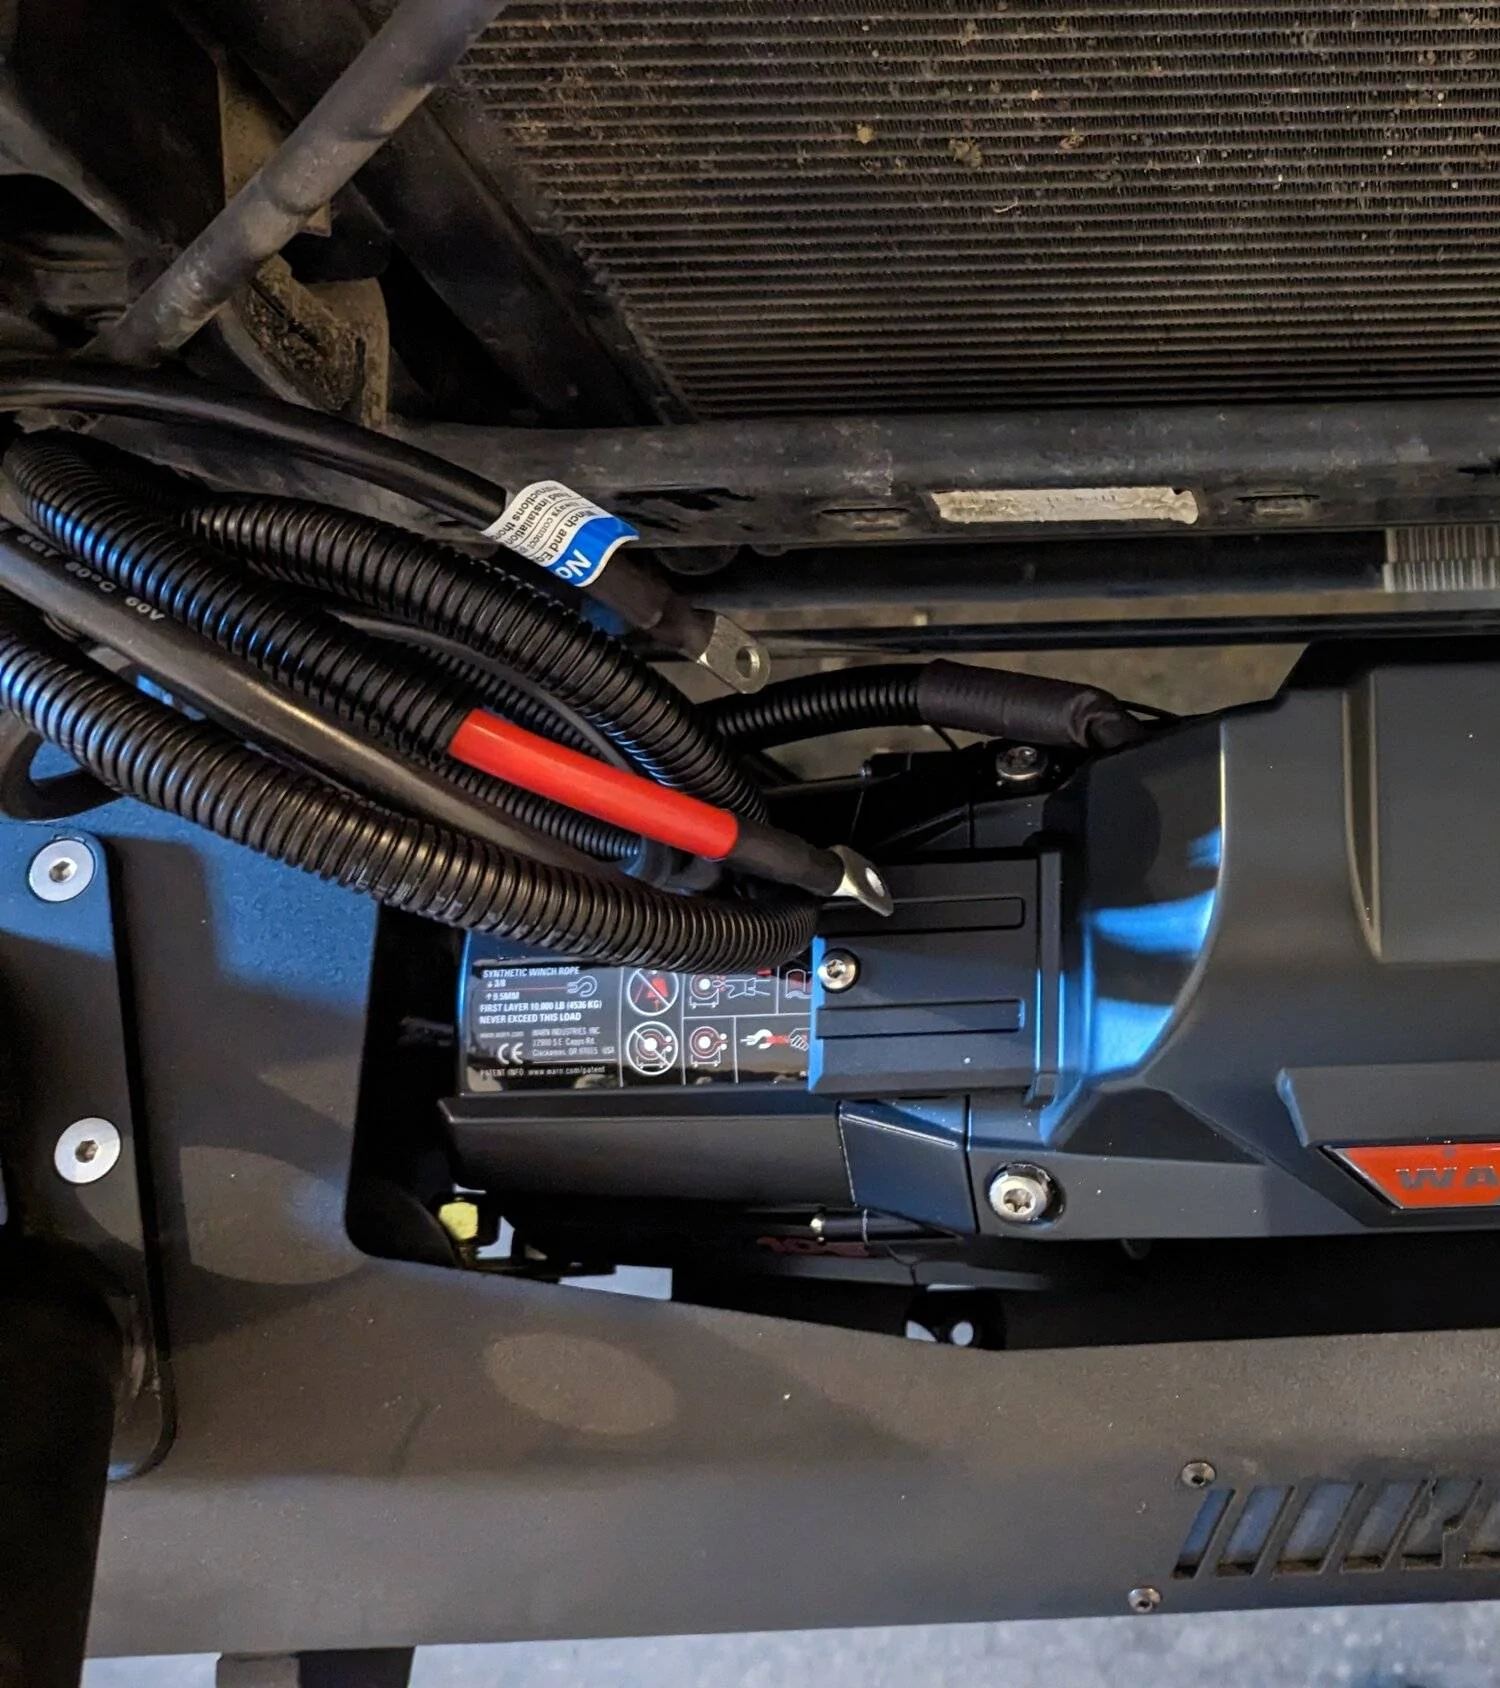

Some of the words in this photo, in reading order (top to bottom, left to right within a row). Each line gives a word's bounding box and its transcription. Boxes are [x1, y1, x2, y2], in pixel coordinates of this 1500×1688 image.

[504, 497, 552, 546] installation
[527, 516, 555, 550] connect
[548, 528, 568, 553] and
[124, 596, 166, 621] 60V
[483, 968, 528, 979] SYNTHETIC
[528, 966, 557, 977] WINCH
[559, 965, 580, 976] ROPE
[480, 1003, 502, 1013] FIRST
[503, 1001, 529, 1012] LAYER
[555, 1000, 565, 1010] LB
[480, 1015, 507, 1025] NEVER
[507, 1013, 538, 1024] EXCEED
[539, 1013, 559, 1022] THIS
[559, 1012, 582, 1022] LOAD
